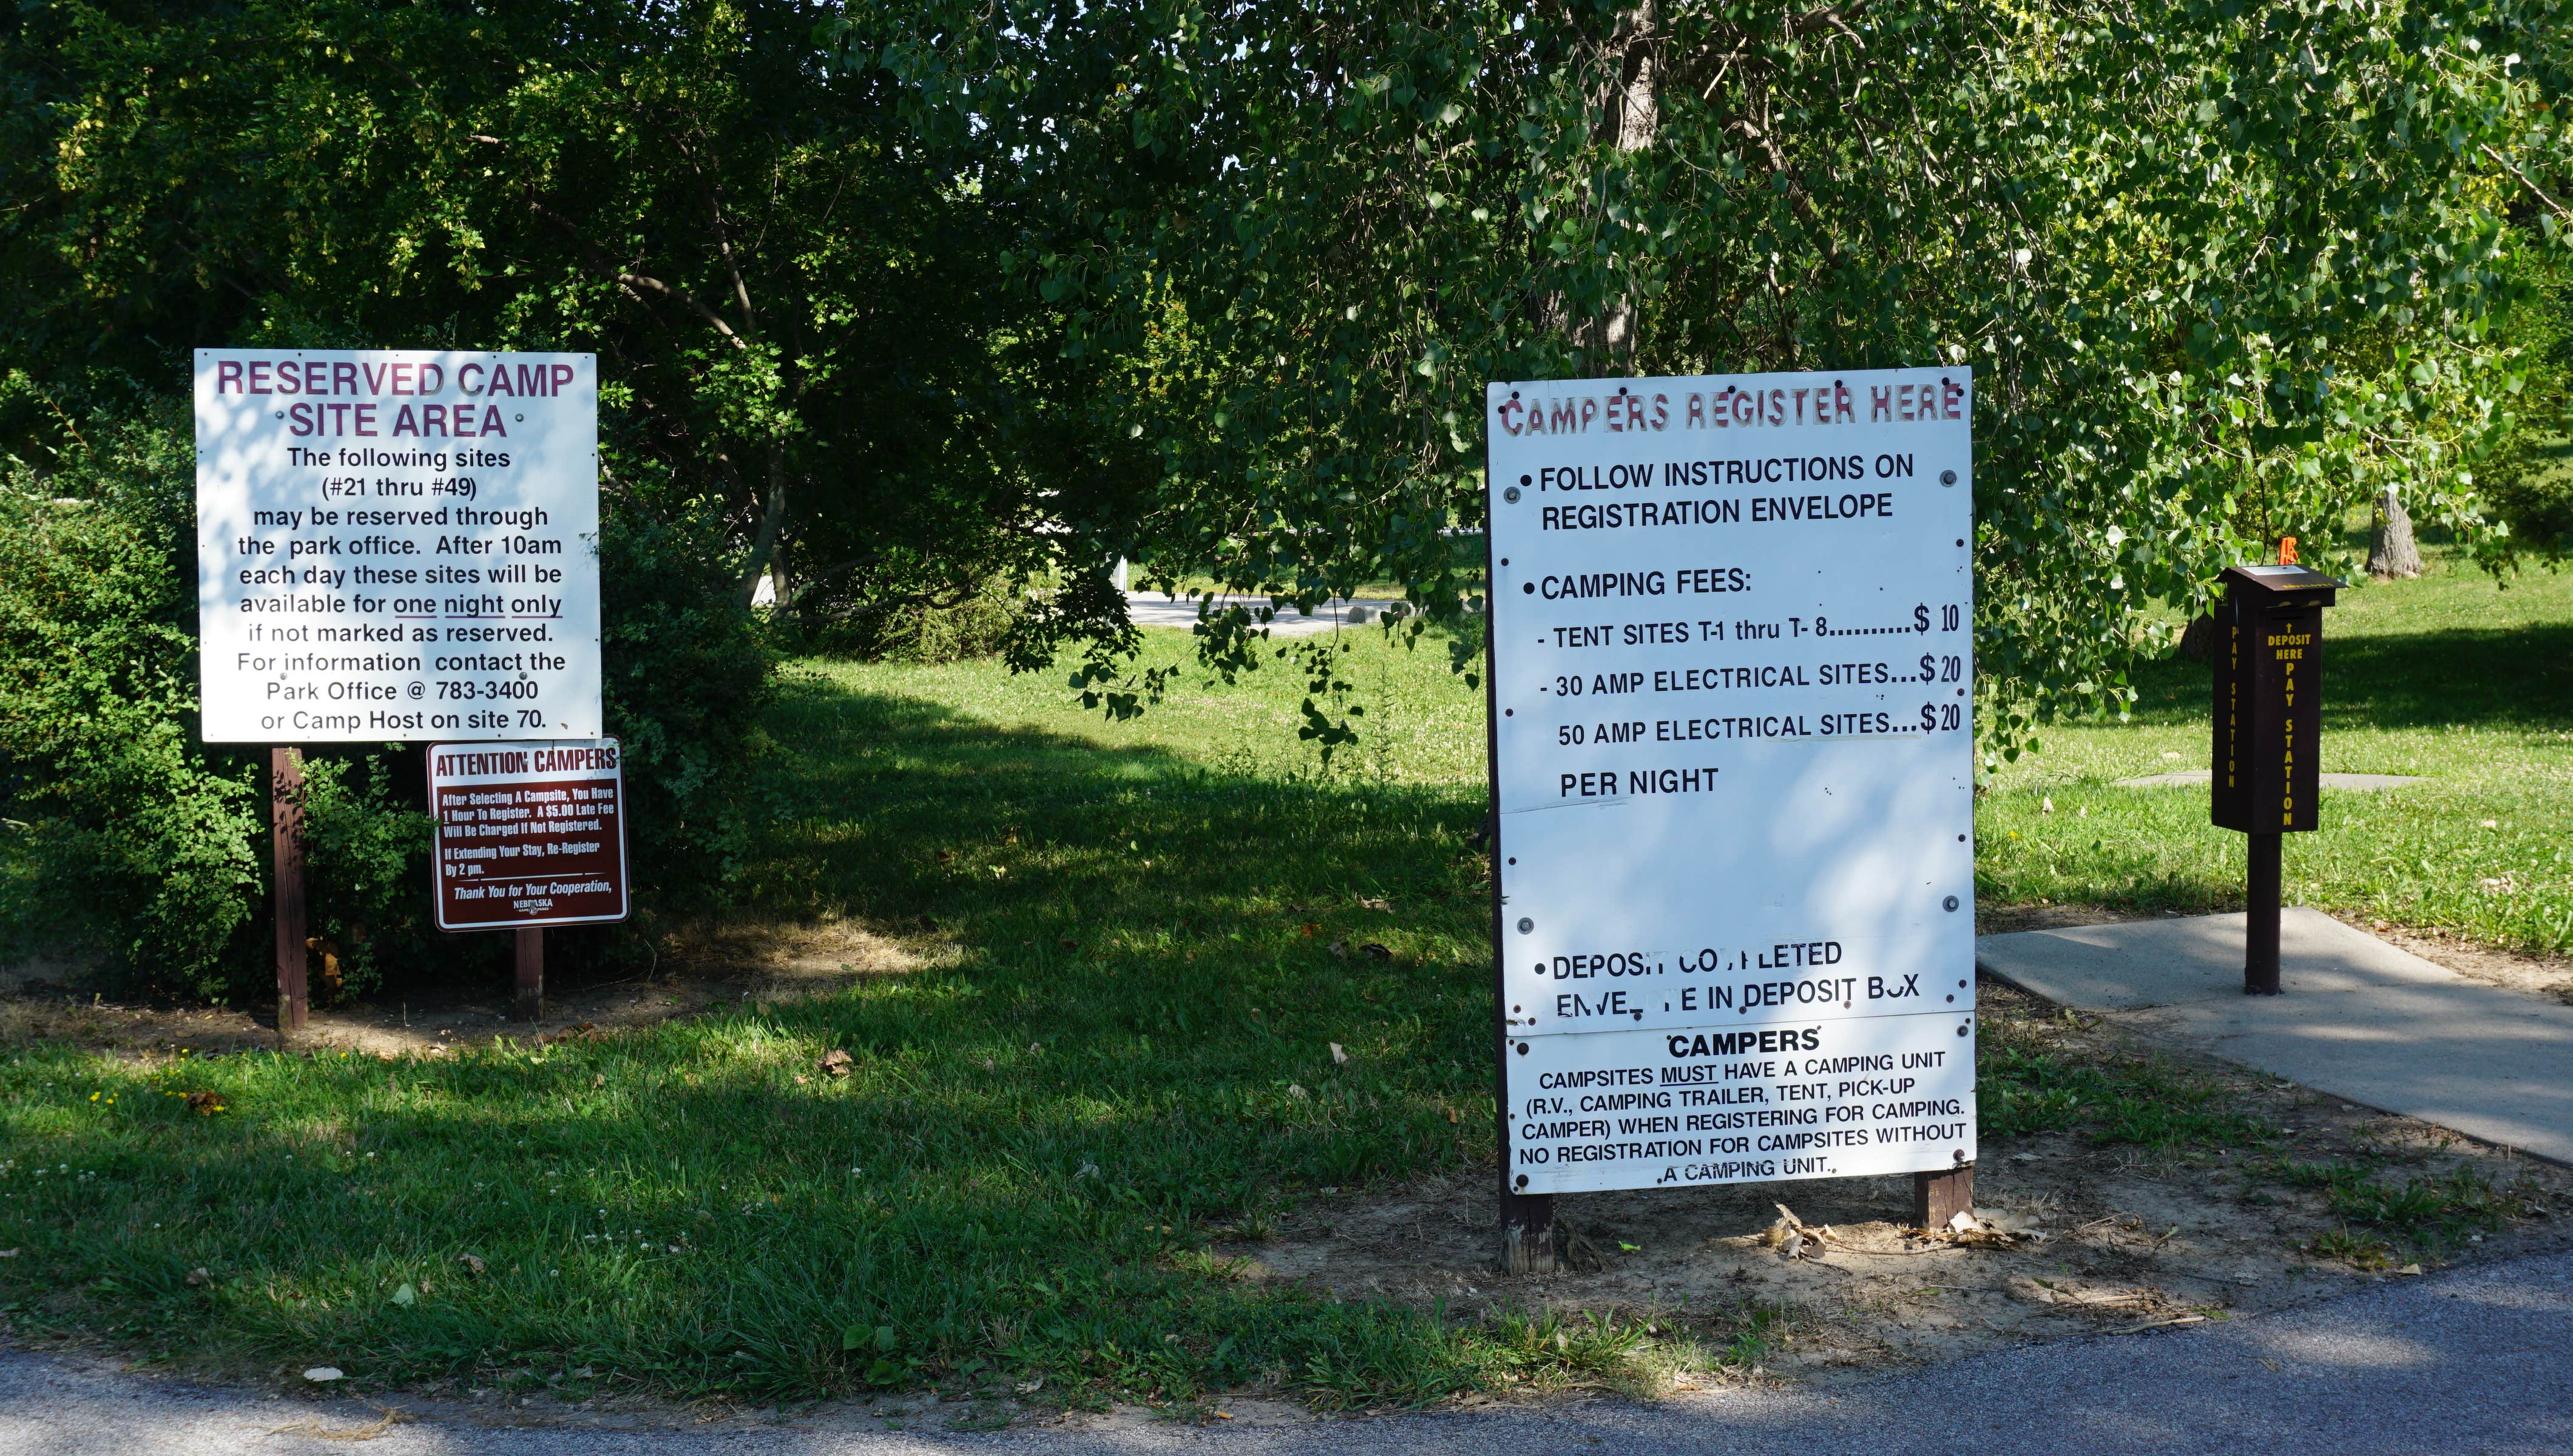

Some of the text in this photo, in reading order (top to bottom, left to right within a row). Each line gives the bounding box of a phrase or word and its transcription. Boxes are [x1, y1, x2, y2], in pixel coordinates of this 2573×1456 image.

[218, 361, 573, 397] RESERVED CAMP
[289, 403, 507, 437] SITE AREA
[1501, 383, 1961, 437] CAMPERS REGISTER HERE
[287, 448, 510, 471] The following sites
[1541, 454, 1912, 491] FOLLOW INSTRUCTIONS ON
[323, 477, 476, 501] (#21 thru #49)
[254, 507, 547, 530] may be reserved through
[1543, 493, 1892, 530] REGISTRATION ENVELOPE
[238, 536, 561, 559] the park office. After 10am
[240, 565, 561, 589] each day these sites will be
[1542, 568, 1750, 599] CAMPING FEES:
[240, 594, 563, 618] available for one night only
[249, 624, 552, 642] if not marked as reserved.
[1554, 625, 1614, 647] TENT
[1624, 622, 1689, 645] SITES
[1699, 621, 1723, 641] T-1
[1736, 620, 1779, 640] thru
[1942, 604, 1958, 631] 10
[2268, 634, 2311, 646] DEPOSIT
[238, 652, 565, 671] For information contact the
[2276, 649, 2302, 660] HERE
[268, 681, 538, 699] Park Office @ 783-3400
[1557, 676, 1582, 696] 30
[1592, 673, 1643, 695] AMP
[1655, 666, 1810, 691] ELECTRICAL
[261, 710, 546, 733] or Camp Host on site 70.
[1559, 725, 1584, 745] 50
[1594, 722, 1645, 743] AMP
[1657, 716, 1811, 741] ELECTRICAL
[2284, 662, 2294, 825] PAY STATION
[436, 747, 617, 777] ATTENTION CAMPERS
[1561, 768, 1718, 797] PER NIGHT
[442, 787, 614, 806] After Selecting A Campsite, You Have
[443, 803, 614, 821] 1 Hour To Register. A $5.00 Late Fee
[444, 819, 602, 838] Will Be Charged If Not Registered.
[445, 841, 600, 860] If Extending Your Stay, Re-Register
[445, 863, 484, 877] By 2 pm.
[455, 880, 612, 900] Thank You for Your Cooperation,
[1679, 941, 1842, 973] COLETED
[1557, 988, 1696, 1018] ENVEE
[1709, 986, 1732, 1009] IN
[1744, 979, 1857, 1008] DEPOSIT
[1669, 1030, 1819, 1057] CAMPERS
[1540, 1051, 1945, 1089] CAMPSITES MUST HAVE A CAMPING UNIT
[1527, 1078, 1915, 1119] (R.V., CAMPING TRAILER, TENT, PICK-UP
[1523, 1099, 1964, 1140] CAMPER) WHEN REGISTERING FOR CAMPING.
[1520, 1123, 1966, 1164] NO REGISTRATION FOR CAMPSITES WITHOUT
[1663, 1156, 1831, 1184] A CAMPING UNIT.
